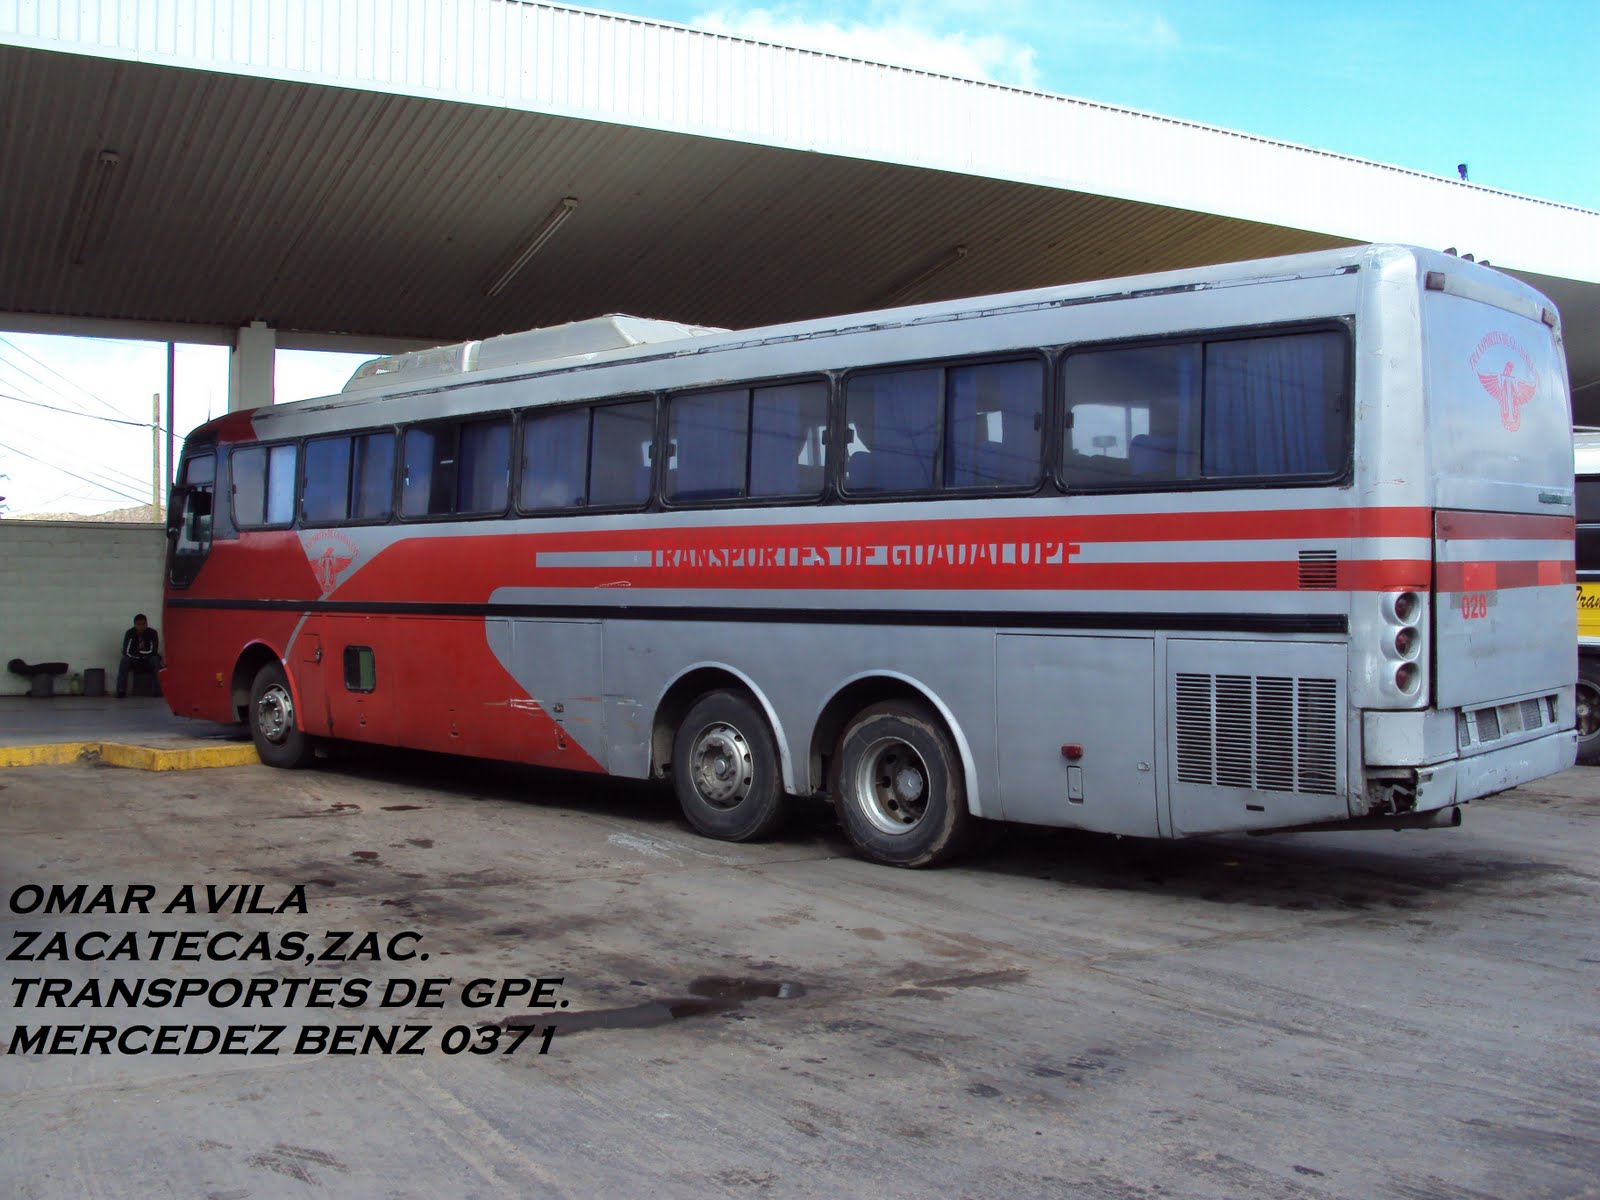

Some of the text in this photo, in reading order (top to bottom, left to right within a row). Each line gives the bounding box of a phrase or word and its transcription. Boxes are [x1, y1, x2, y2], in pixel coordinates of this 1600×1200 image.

[649, 529, 1083, 577] TRANSPORTES DE GUADALUPE
[1462, 594, 1487, 620] 028
